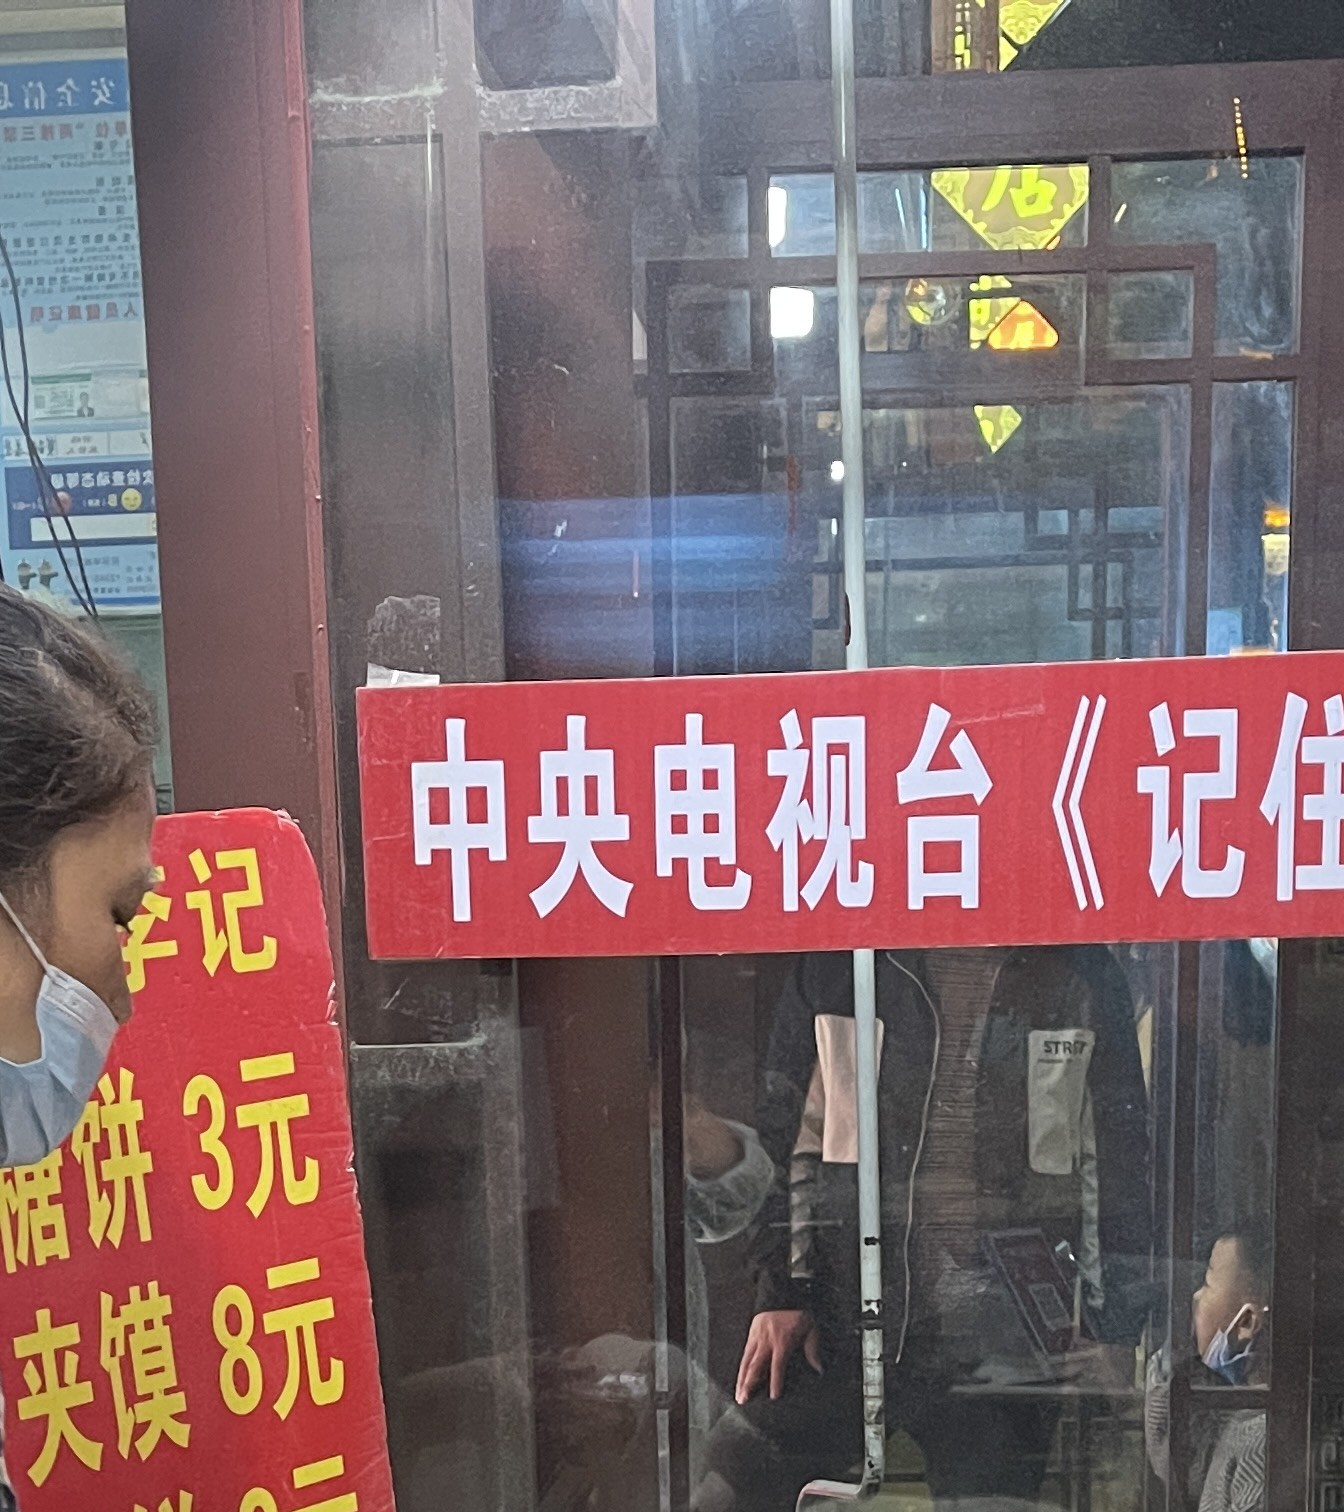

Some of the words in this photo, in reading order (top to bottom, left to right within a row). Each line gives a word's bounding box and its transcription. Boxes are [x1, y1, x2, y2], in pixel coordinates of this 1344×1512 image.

[183, 1052, 320, 1218] 3元
[13, 1281, 192, 1488] 夹馍
[212, 1257, 346, 1420] 8元
